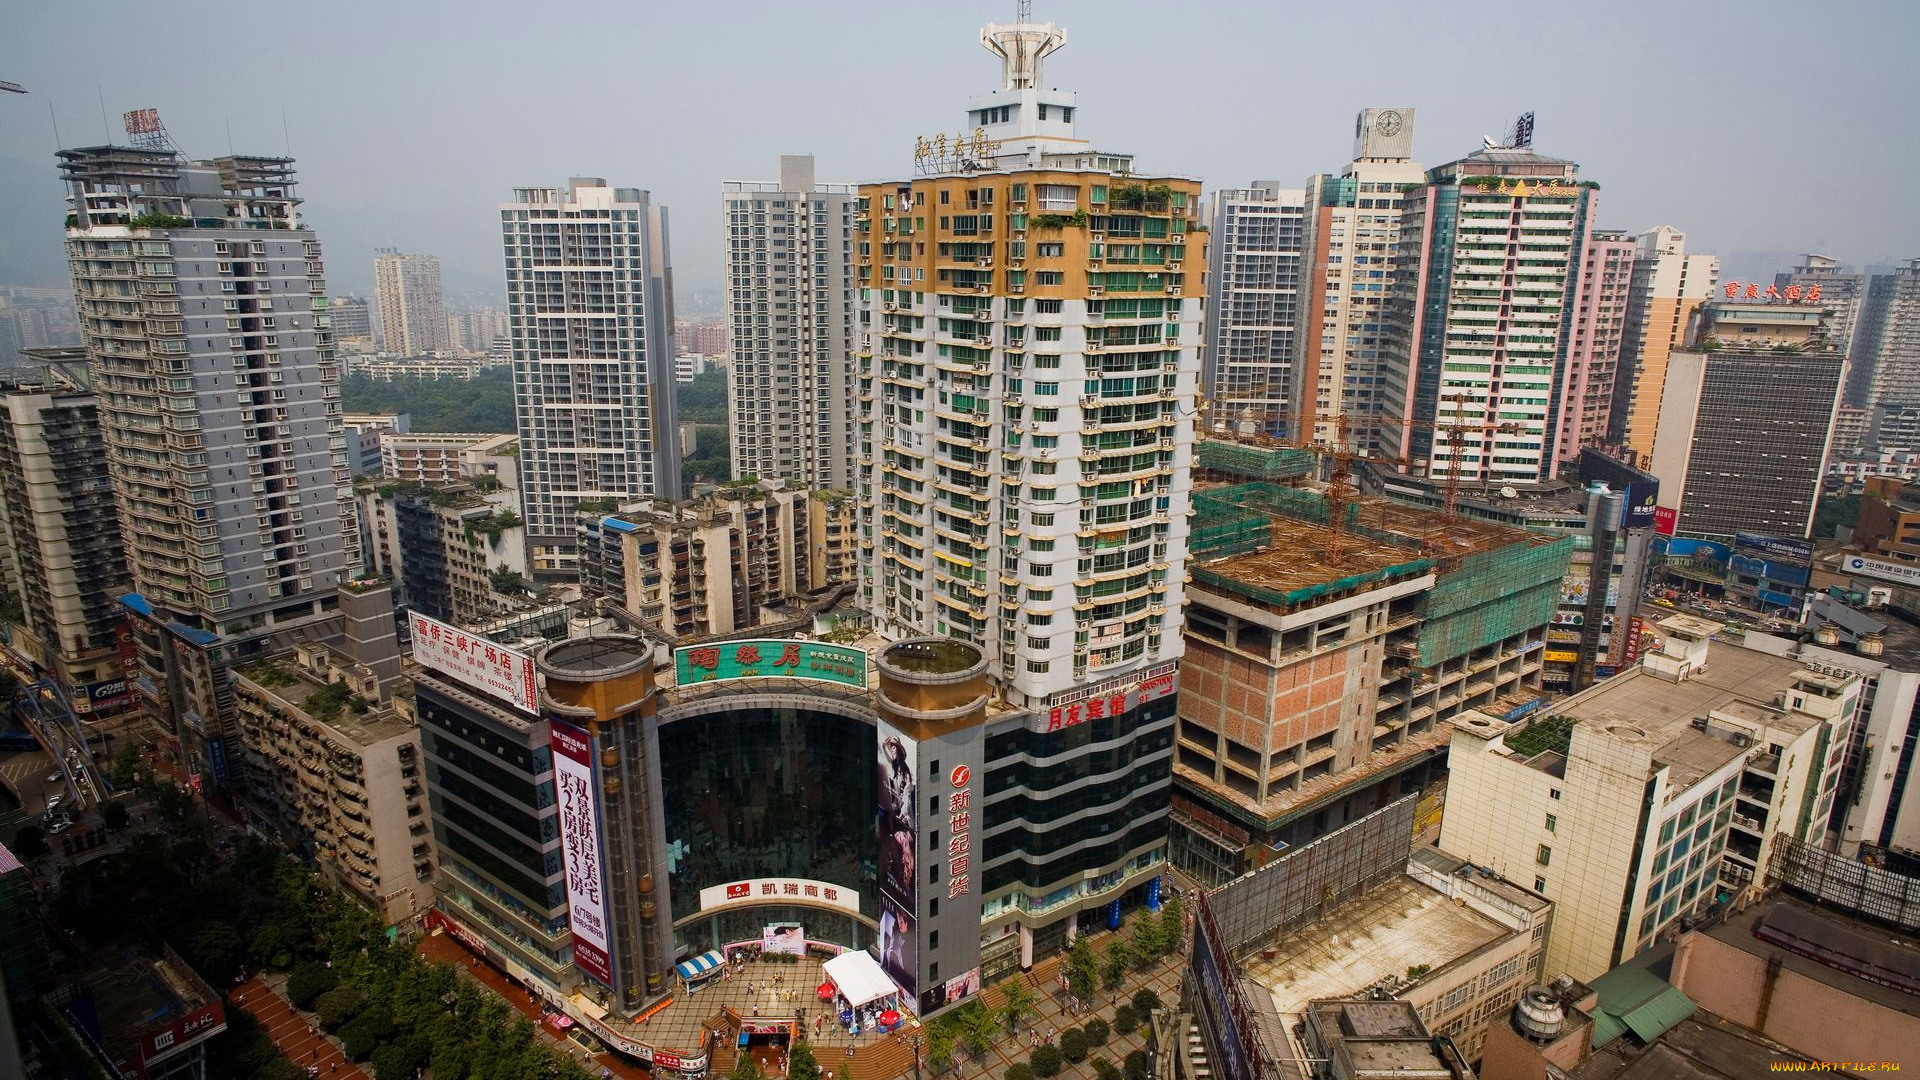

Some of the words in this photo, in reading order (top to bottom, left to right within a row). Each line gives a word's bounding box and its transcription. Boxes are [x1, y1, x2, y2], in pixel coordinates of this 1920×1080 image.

[417, 619, 512, 671] 富侨三峡广场店
[688, 644, 801, 682] 陶然居
[95, 680, 127, 698] GOME
[1047, 694, 1127, 732] 月友宾馆
[559, 768, 583, 896] 买2房变3房
[949, 789, 970, 899] 新世纪百货
[762, 883, 838, 901] 凯瑞商都
